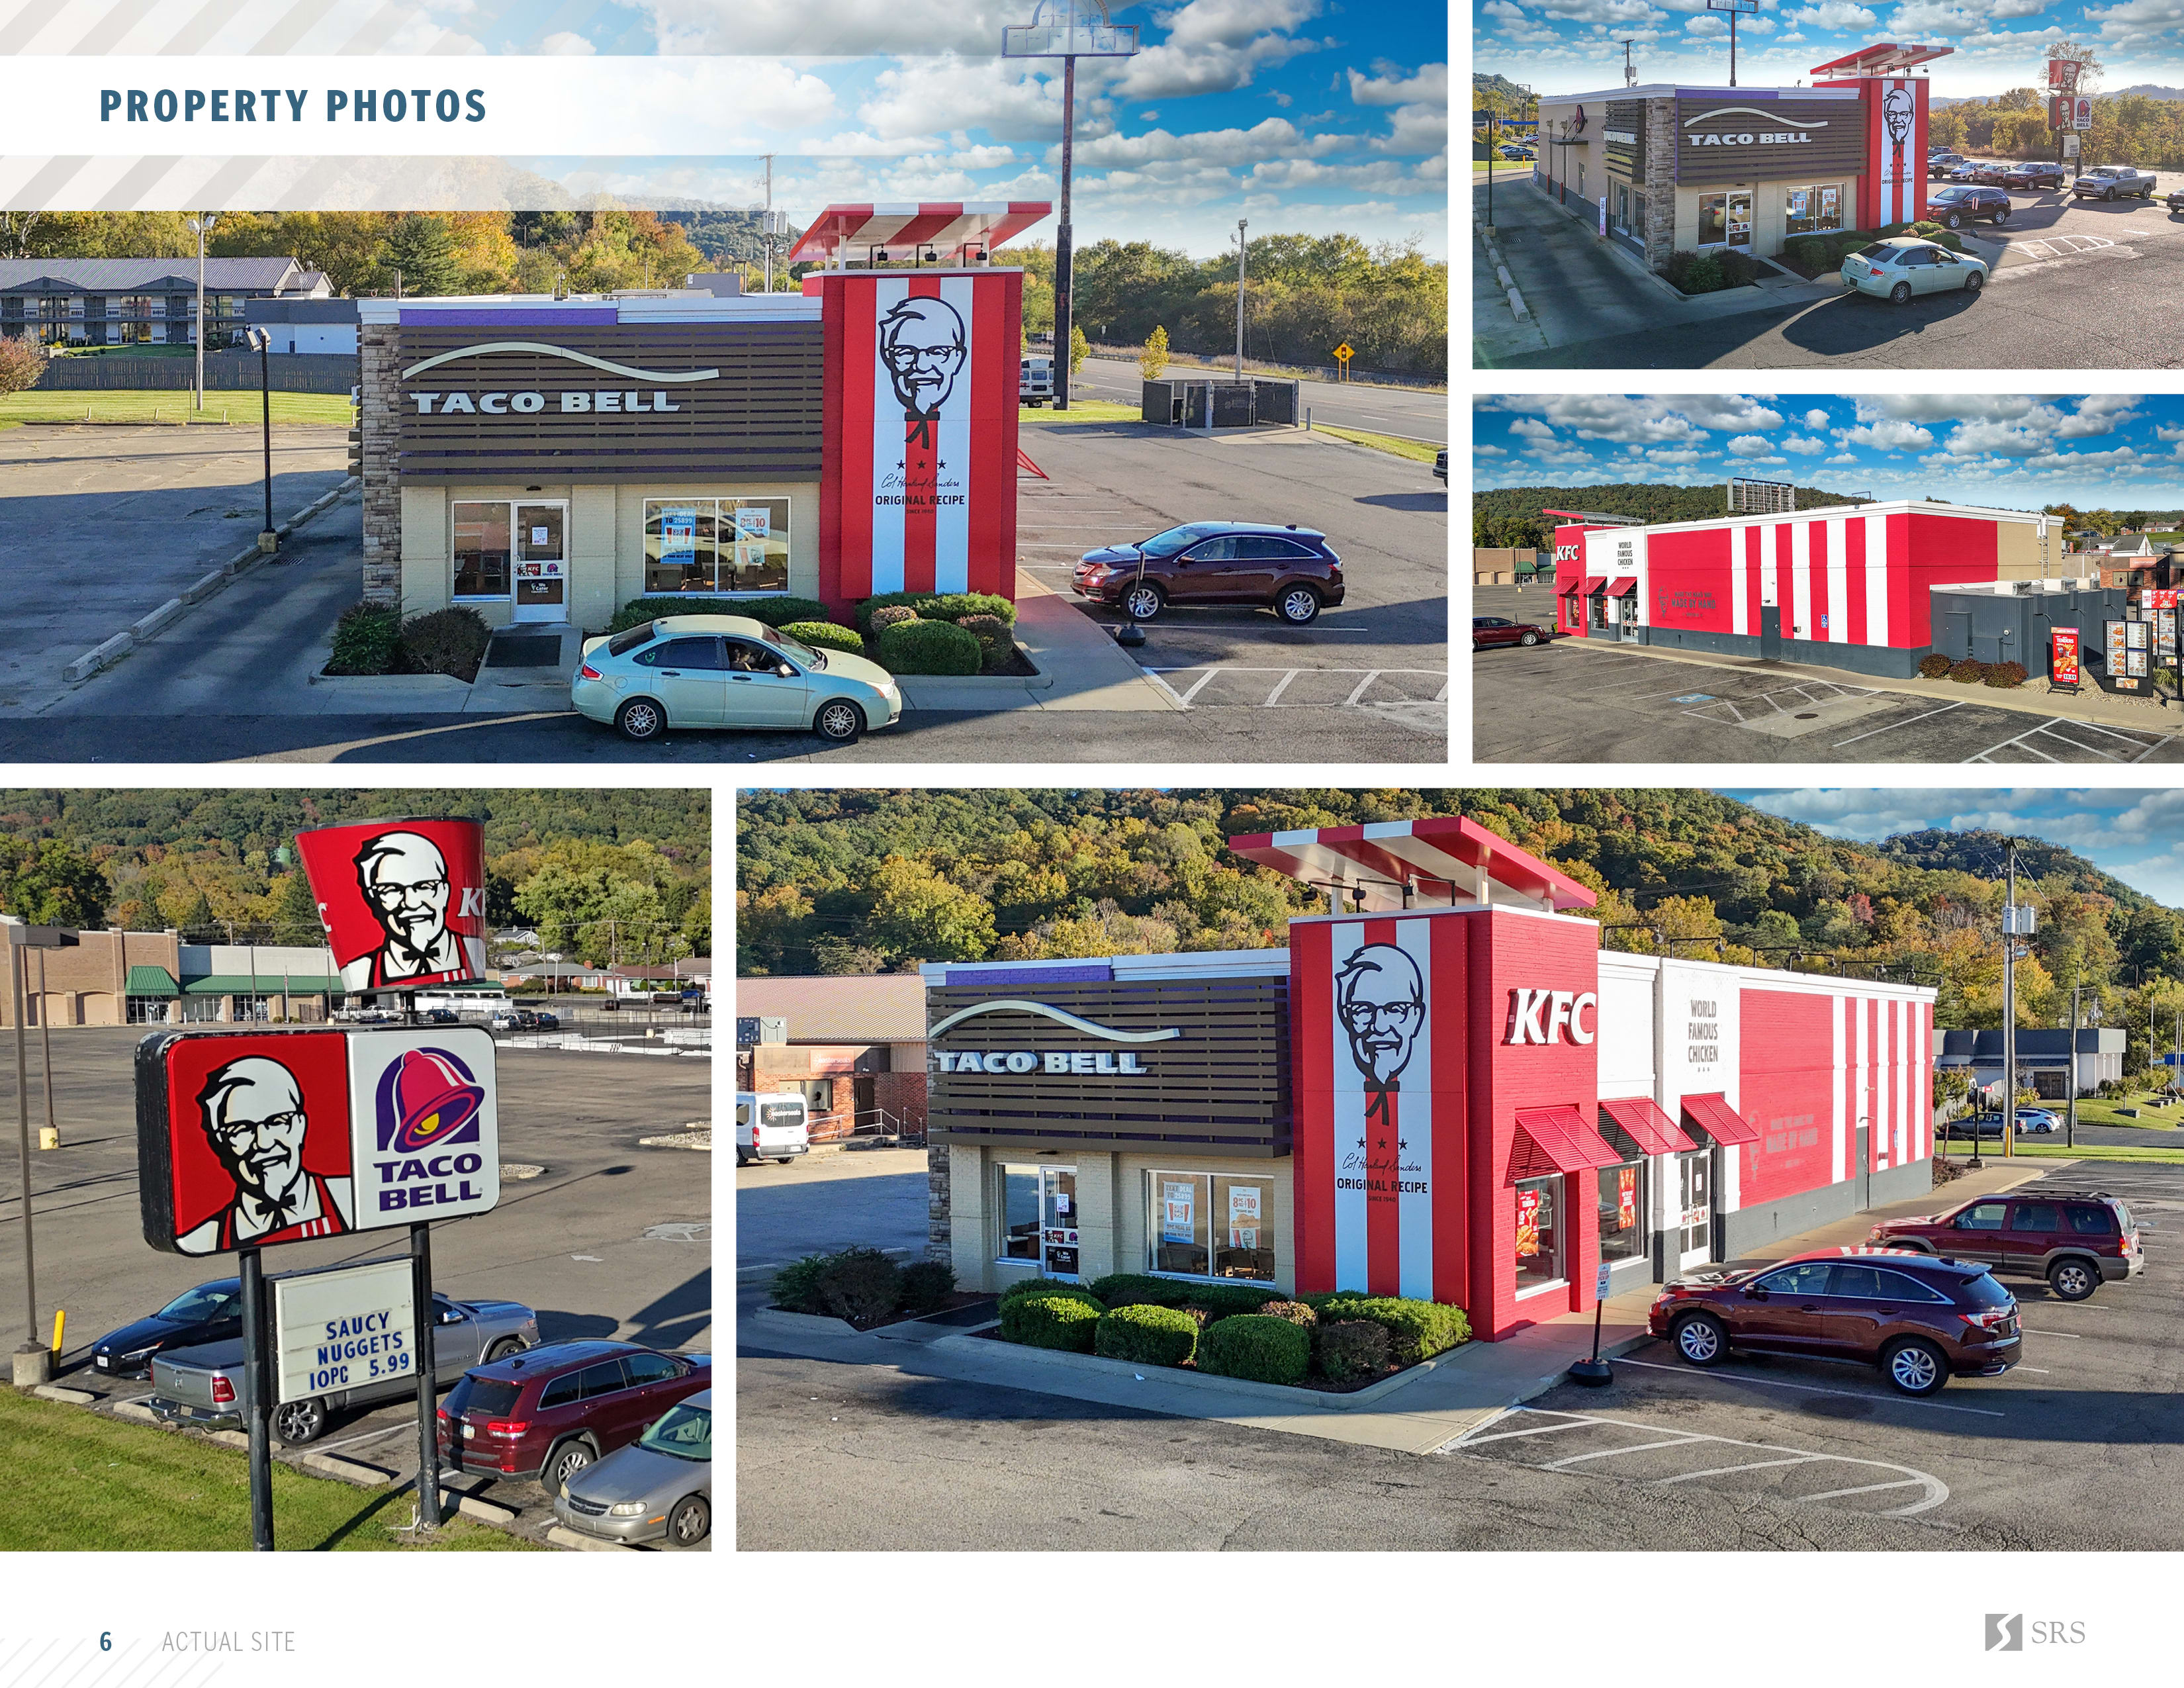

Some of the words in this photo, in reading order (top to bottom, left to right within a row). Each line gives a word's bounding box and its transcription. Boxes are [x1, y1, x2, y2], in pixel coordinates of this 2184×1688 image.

[1688, 133, 1754, 146] TACO
[1759, 132, 1812, 144] BELL
[409, 392, 545, 413] TACO
[561, 391, 680, 412] BELL
[876, 495, 925, 505] ORIGINAL
[929, 495, 965, 505] RECIPE
[740, 518, 746, 528] 8
[1556, 545, 1580, 561] KFC
[1672, 598, 1688, 608] MADE
[1689, 598, 1696, 608] BY
[1698, 599, 1715, 609] HAND
[1508, 988, 1597, 1045] KFC
[1690, 1000, 1717, 1017] WORLD
[1688, 1022, 1718, 1040] FAMOUS
[934, 1052, 1038, 1073] TACO
[1044, 1053, 1148, 1074] BELL
[1688, 1045, 1718, 1063] CHICKEN
[373, 1153, 482, 1184] TACO
[1342, 1152, 1359, 1170] Col
[1337, 1178, 1387, 1192] ORIGINAL
[1391, 1180, 1428, 1194] RECIPE
[379, 1180, 482, 1212] BELL
[1233, 1197, 1238, 1207] 8
[326, 1311, 390, 1340] SAUCY
[317, 1331, 403, 1366] NUGGETS
[369, 1352, 410, 1377] 5.99
